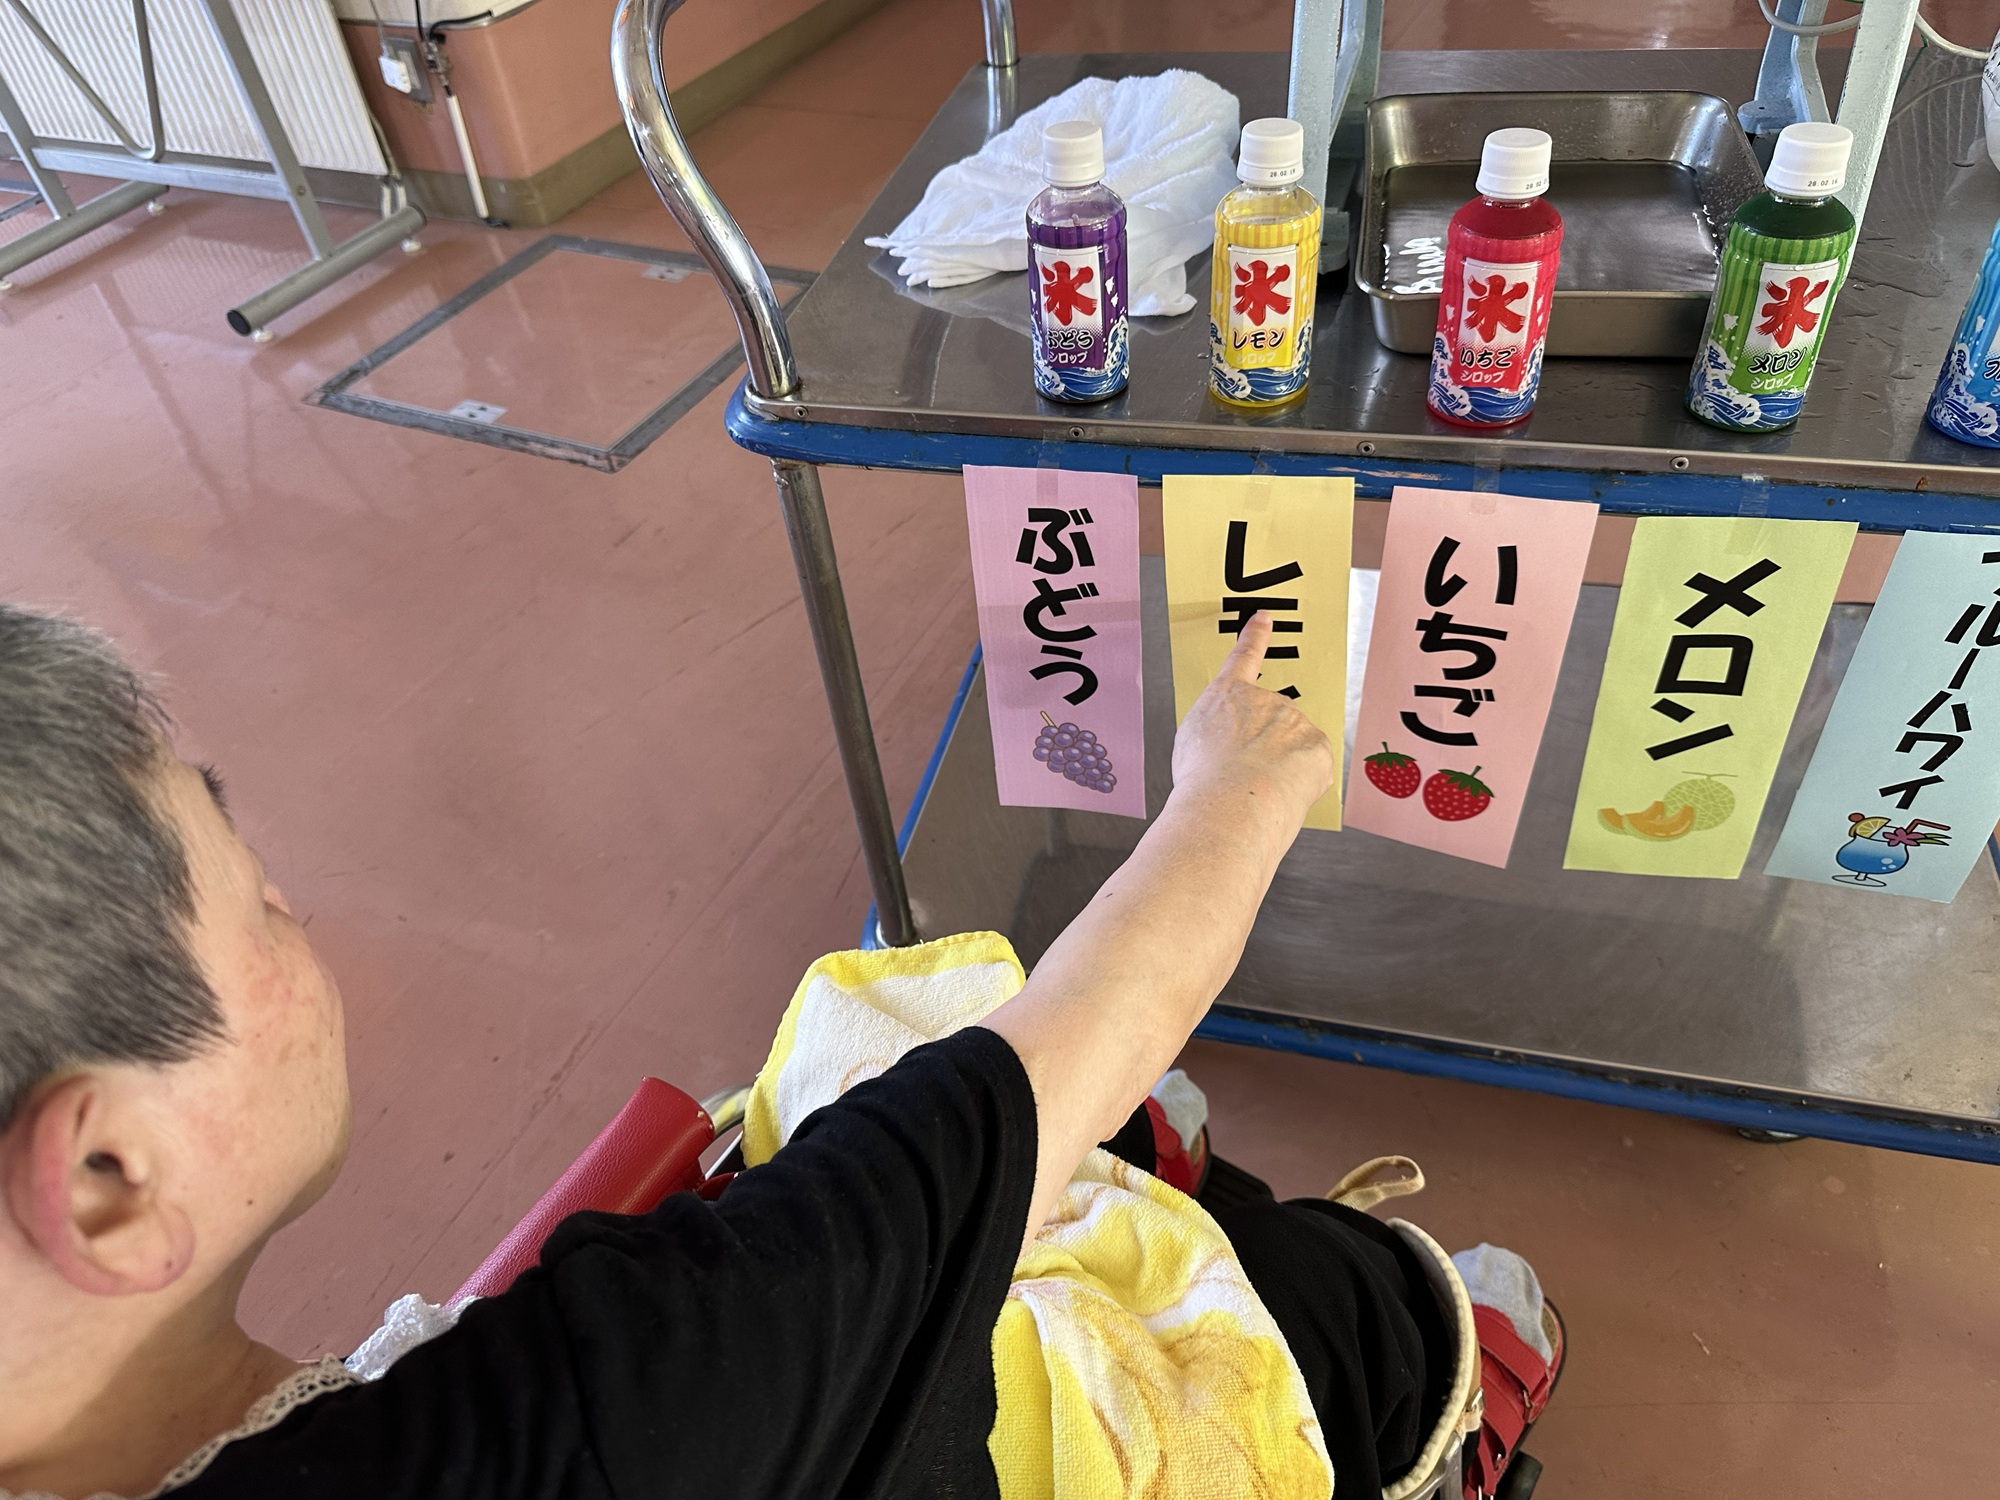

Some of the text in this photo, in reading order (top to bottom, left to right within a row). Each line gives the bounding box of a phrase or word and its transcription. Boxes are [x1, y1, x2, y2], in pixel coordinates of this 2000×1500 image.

[1041, 260, 1098, 326] 氷
[1233, 259, 1291, 326] 氷
[1464, 274, 1529, 343] 氷
[1755, 276, 1829, 349] 氷
[1049, 351, 1088, 364] シロップ
[1233, 328, 1285, 350] レモン
[1236, 352, 1276, 364] シロップ
[1460, 346, 1516, 368] いちご
[1748, 347, 1807, 375] メロン
[1461, 370, 1505, 384] シロップ
[1751, 371, 1794, 390] シロップ
[1015, 507, 1100, 706] ぶどう
[1218, 520, 1304, 700] レモ
[1399, 536, 1518, 746] いちご
[1644, 558, 1782, 761] メロン
